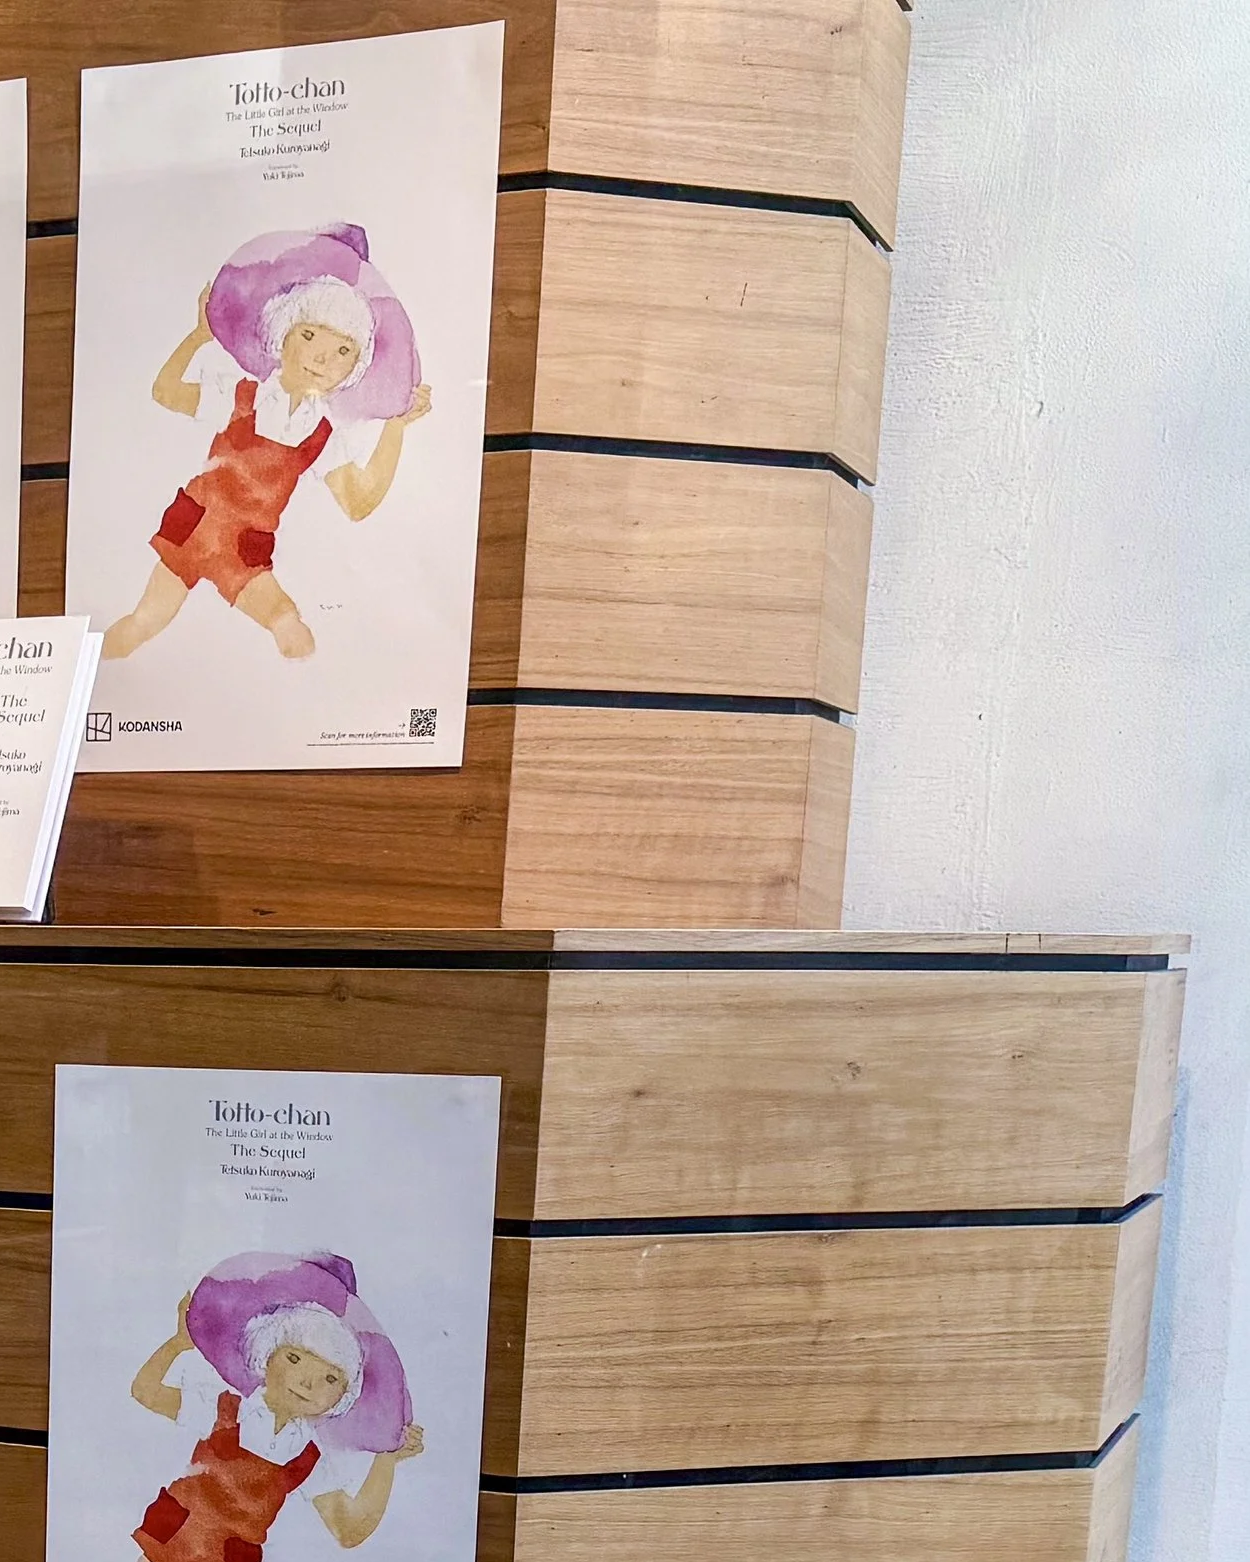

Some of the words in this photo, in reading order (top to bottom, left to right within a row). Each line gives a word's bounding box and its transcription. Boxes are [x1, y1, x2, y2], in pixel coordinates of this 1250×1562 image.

[229, 77, 345, 106] Totto-chan
[249, 125, 274, 138] The
[276, 119, 321, 137] Sequel
[1, 695, 28, 707] The
[118, 721, 184, 732] KODANSHA
[208, 1099, 331, 1126] Totto-chan
[230, 1143, 256, 1157] The
[260, 1145, 306, 1162] Sequel
